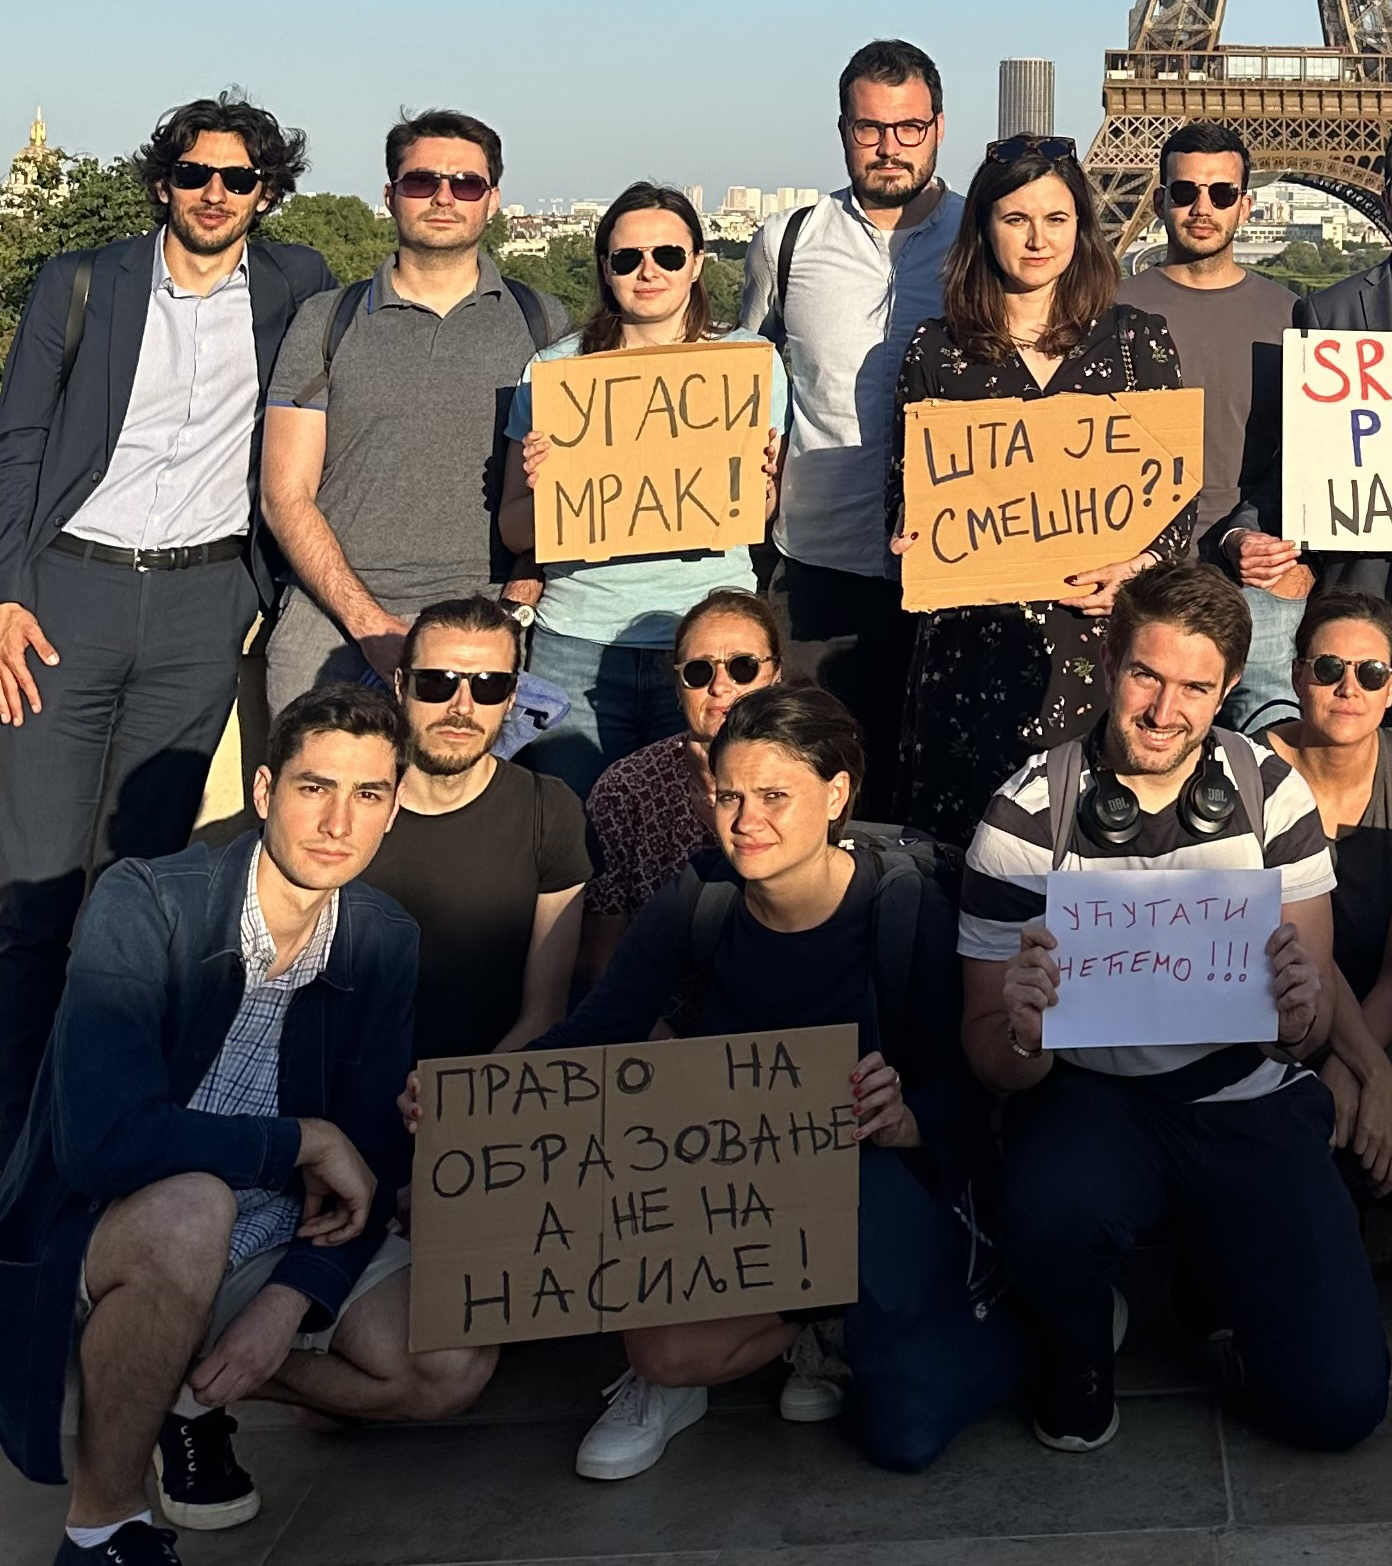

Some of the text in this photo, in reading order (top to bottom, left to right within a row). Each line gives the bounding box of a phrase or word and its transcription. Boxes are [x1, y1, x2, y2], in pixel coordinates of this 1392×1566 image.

[550, 373, 760, 447] УГАСИ
[923, 415, 1140, 486] ШТА ЈЕ
[932, 457, 1183, 563] СМЕШНО?!
[1063, 897, 1249, 931] УЋУТАТИ
[435, 1040, 802, 1122] ПРАВО НА
[432, 1104, 856, 1198] ОБРАЗОВАЊЕ
[533, 1182, 774, 1255] А НЕ НА
